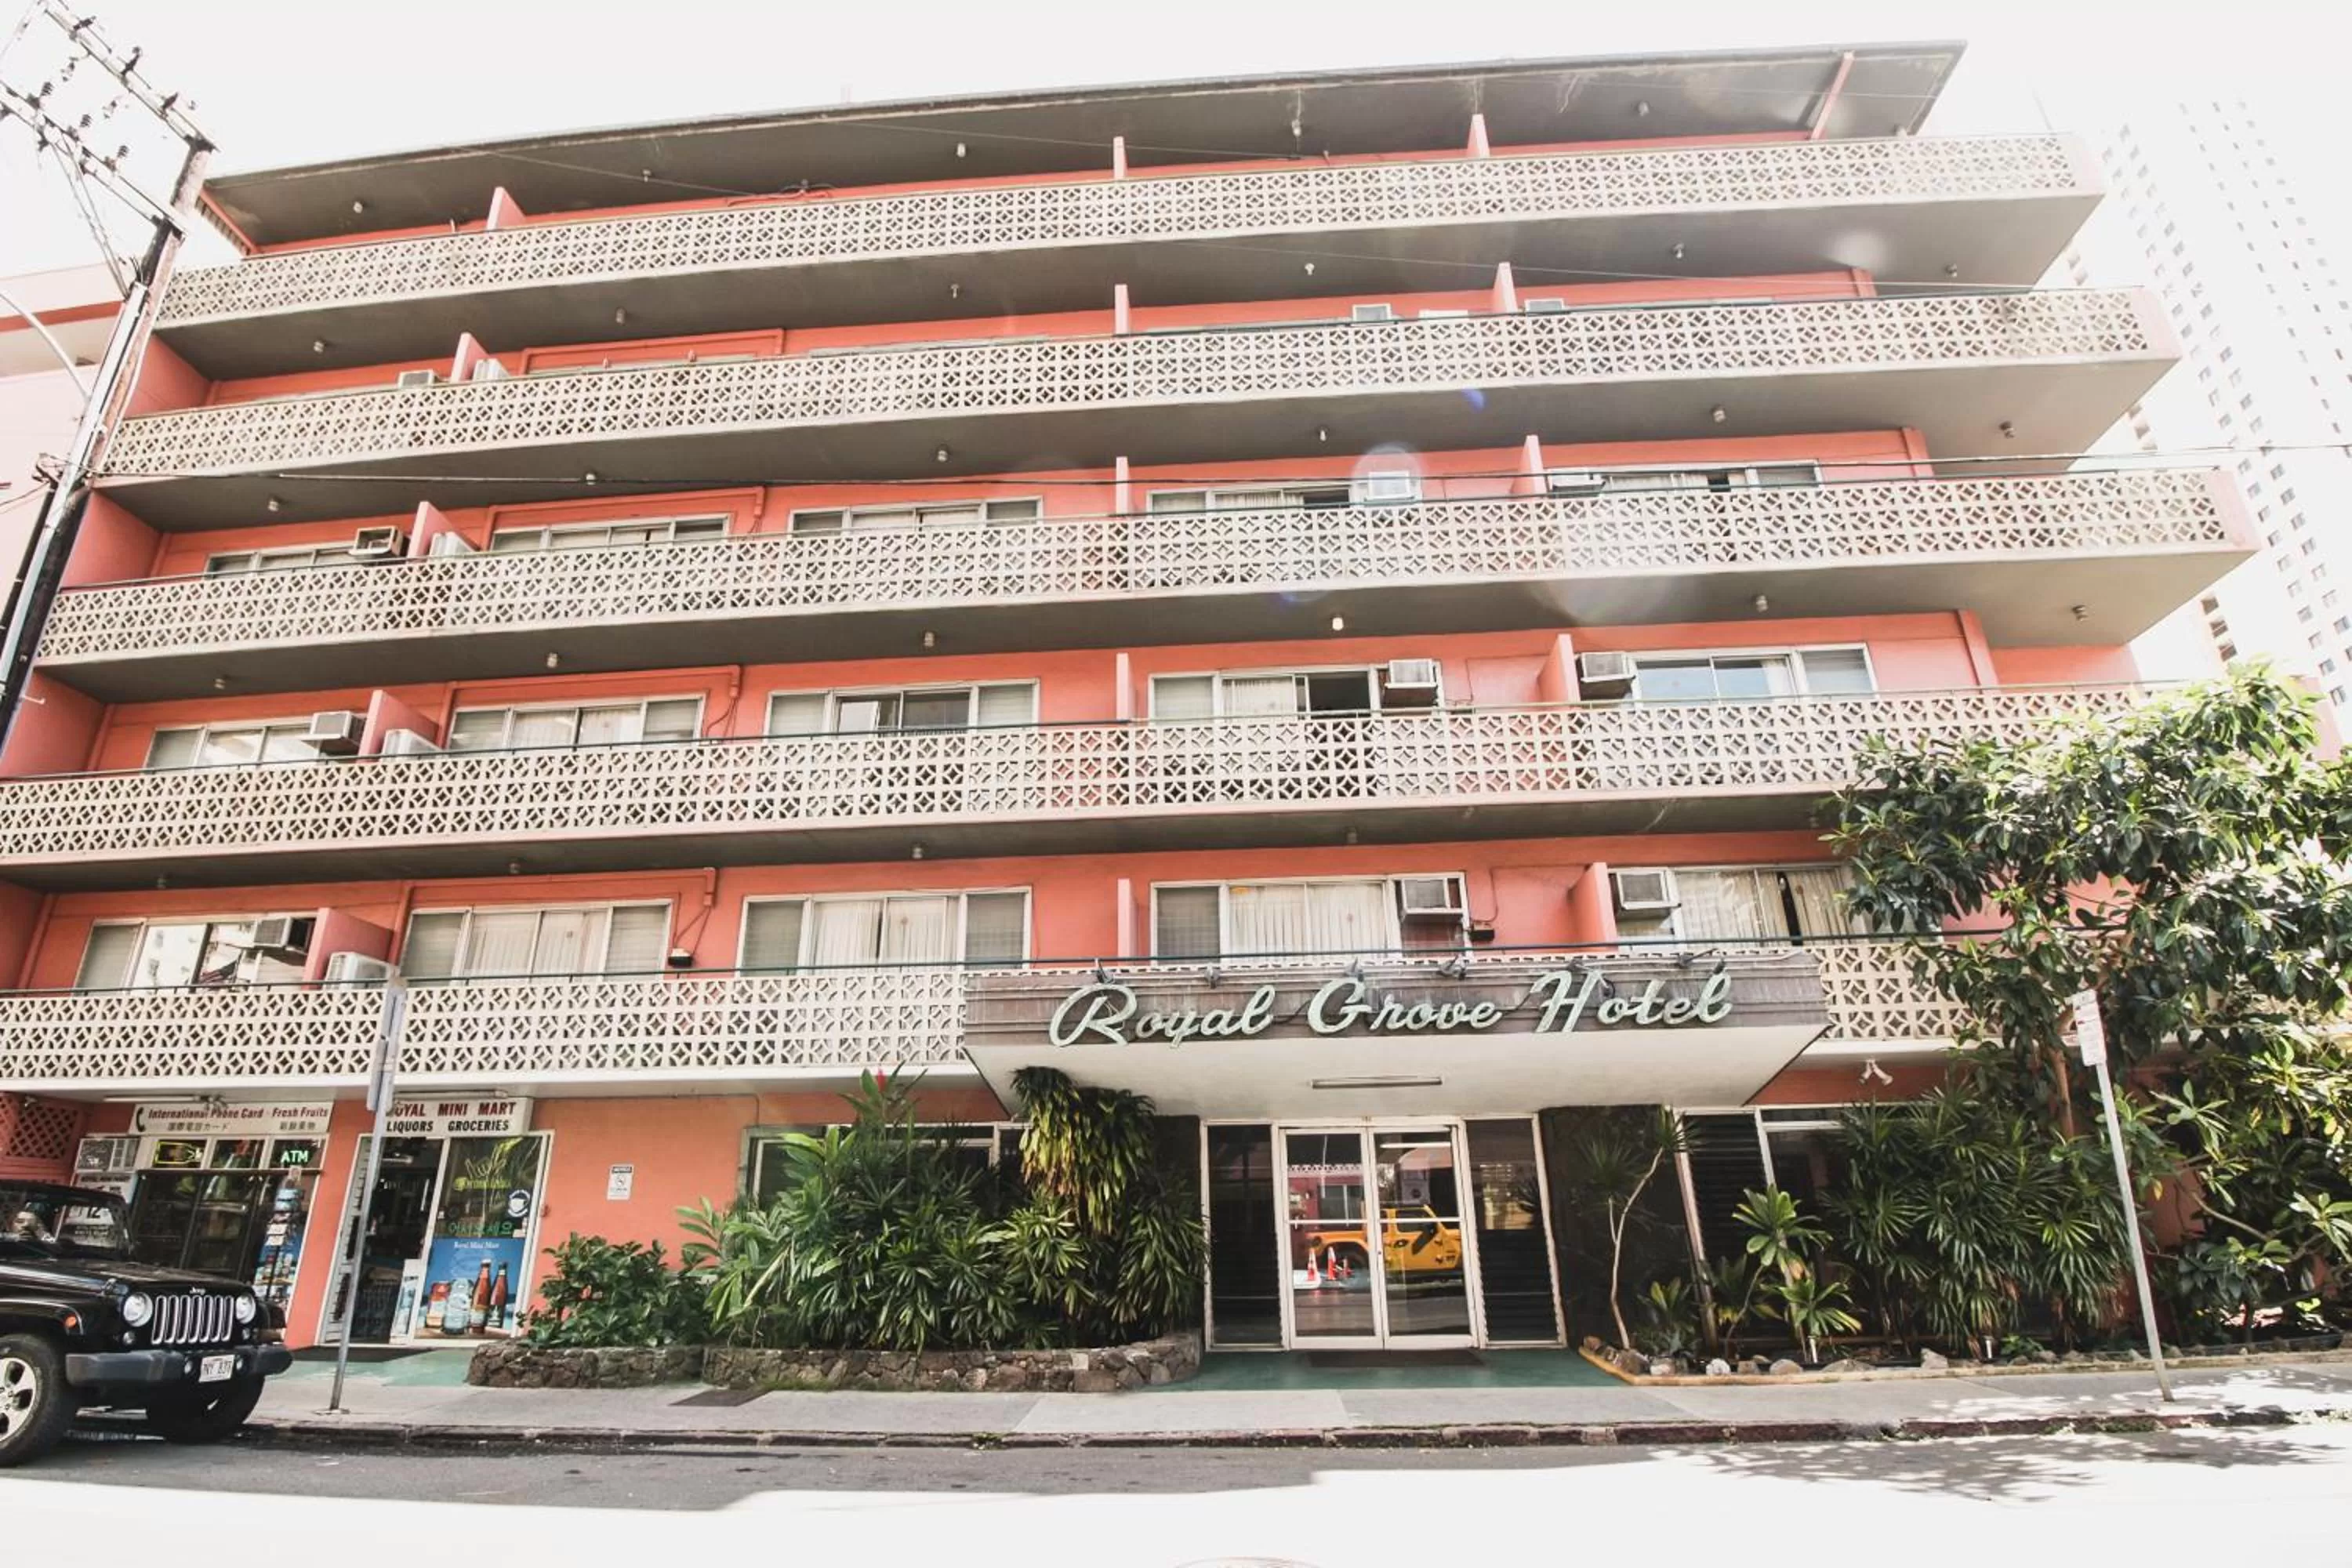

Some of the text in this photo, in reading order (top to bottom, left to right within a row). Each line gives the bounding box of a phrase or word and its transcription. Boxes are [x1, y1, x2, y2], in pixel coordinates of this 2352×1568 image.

[1049, 969, 1733, 1048] Royal Grove Hotel
[148, 1106, 328, 1119] International Phone Card Fresh Fruits
[387, 1102, 516, 1116] OYAL MINI MART
[386, 1120, 510, 1133] LIQUORS GROCERIES
[281, 1150, 309, 1163] ATM
